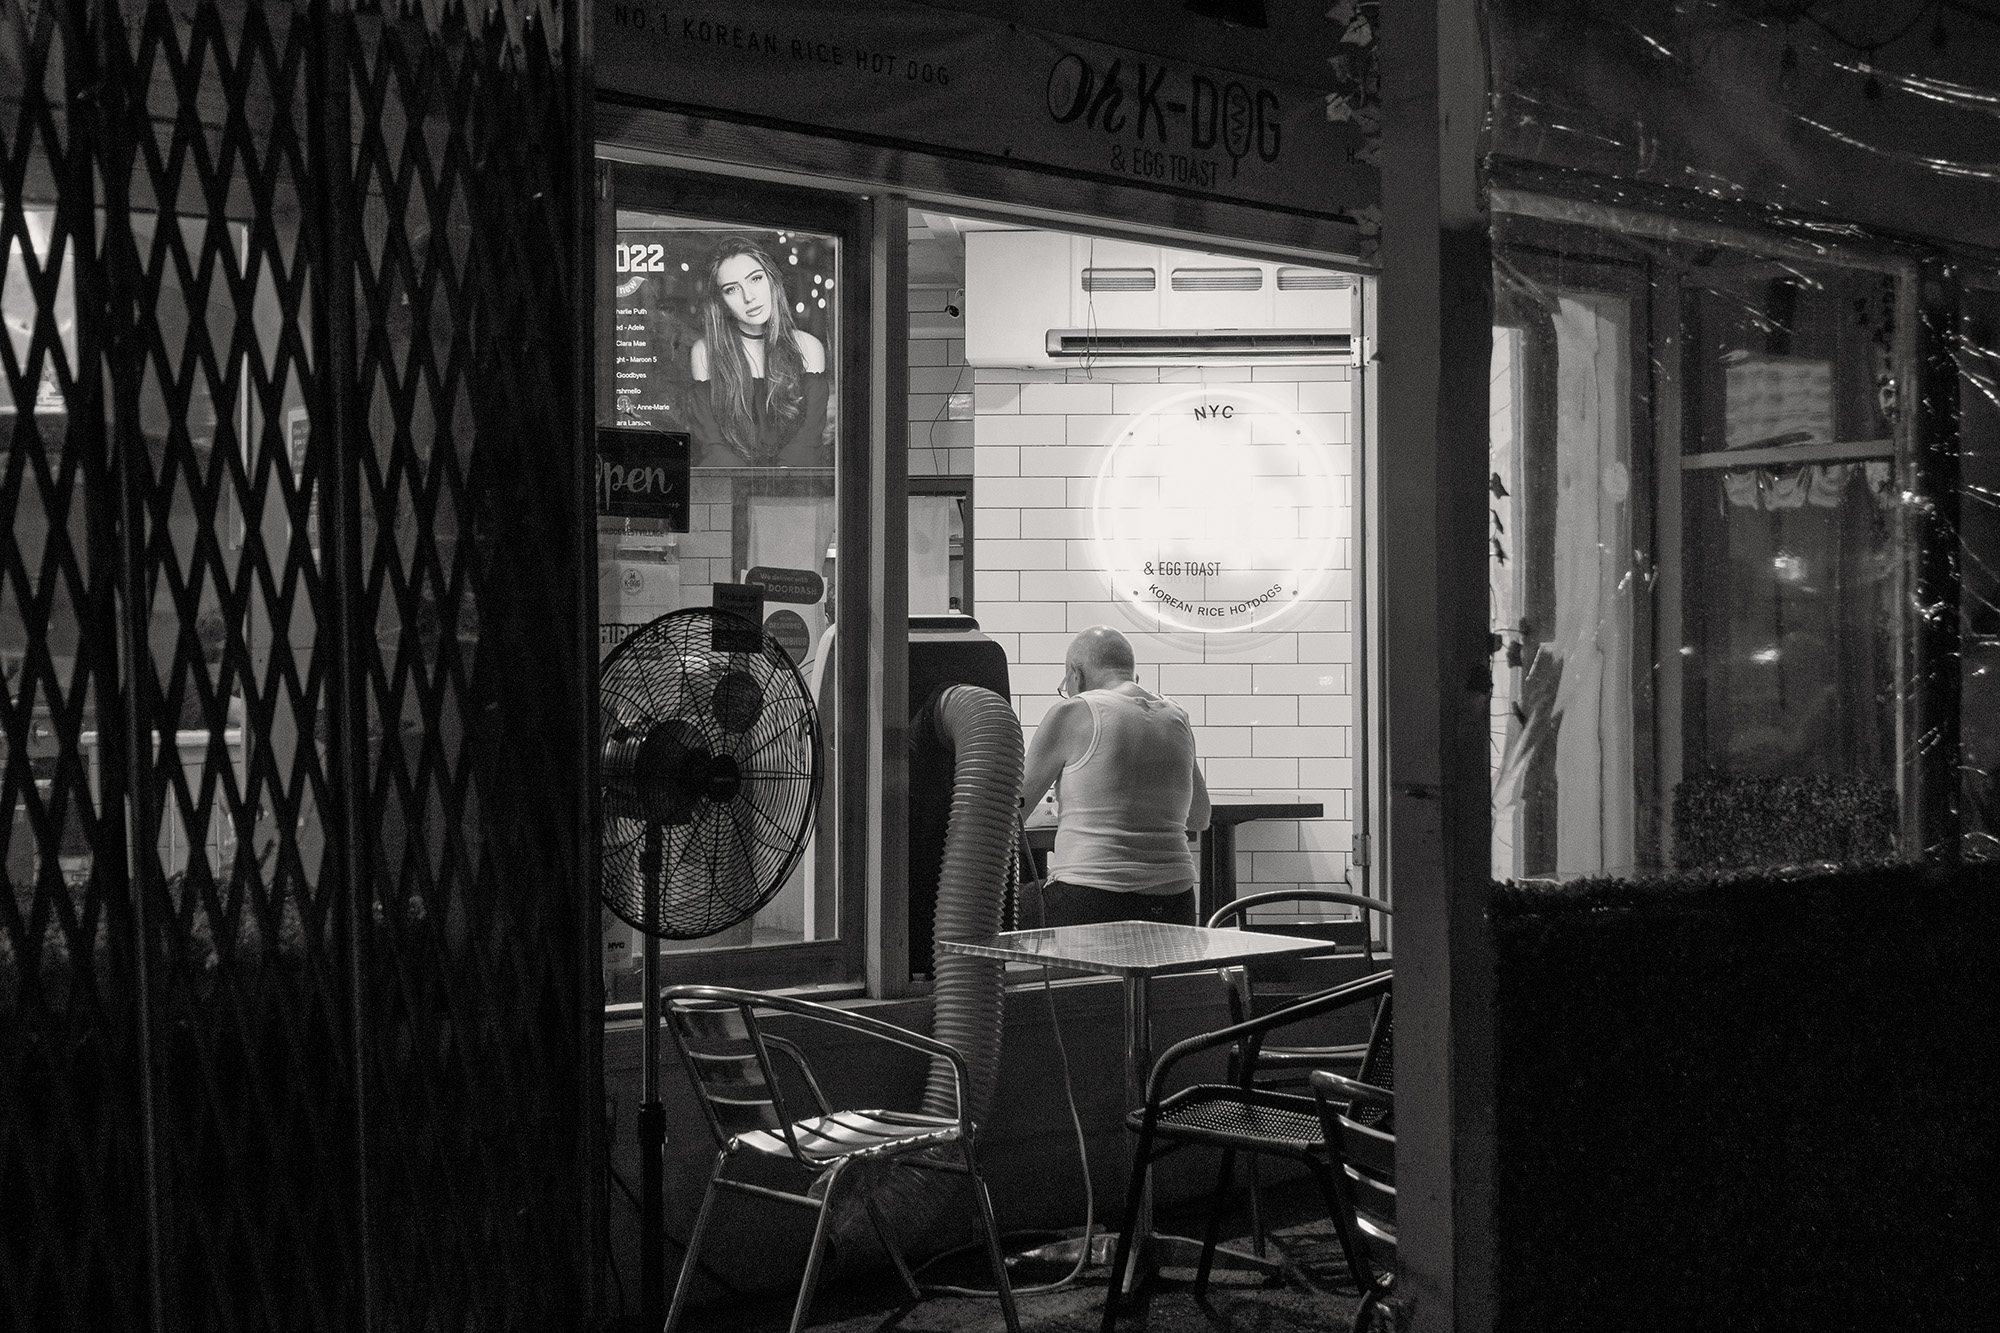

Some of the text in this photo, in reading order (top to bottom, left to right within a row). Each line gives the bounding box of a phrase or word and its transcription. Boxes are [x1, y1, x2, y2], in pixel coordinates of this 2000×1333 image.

[683, 18, 777, 54] KOREAN
[792, 39, 843, 65] RICE
[856, 50, 897, 75] HOT
[907, 60, 949, 85] DOG
[1047, 53, 1281, 178] Oh K-DOG
[1110, 145, 1219, 188] & EGG TOAST
[620, 280, 637, 294] new
[637, 403, 670, 411] Anne-Marie
[1194, 405, 1234, 421] NYC
[1143, 561, 1221, 577] & EGG TOAST
[768, 584, 818, 596] DOORDASH
[1148, 583, 1282, 617] KOREAN RICE HOTDOGS
